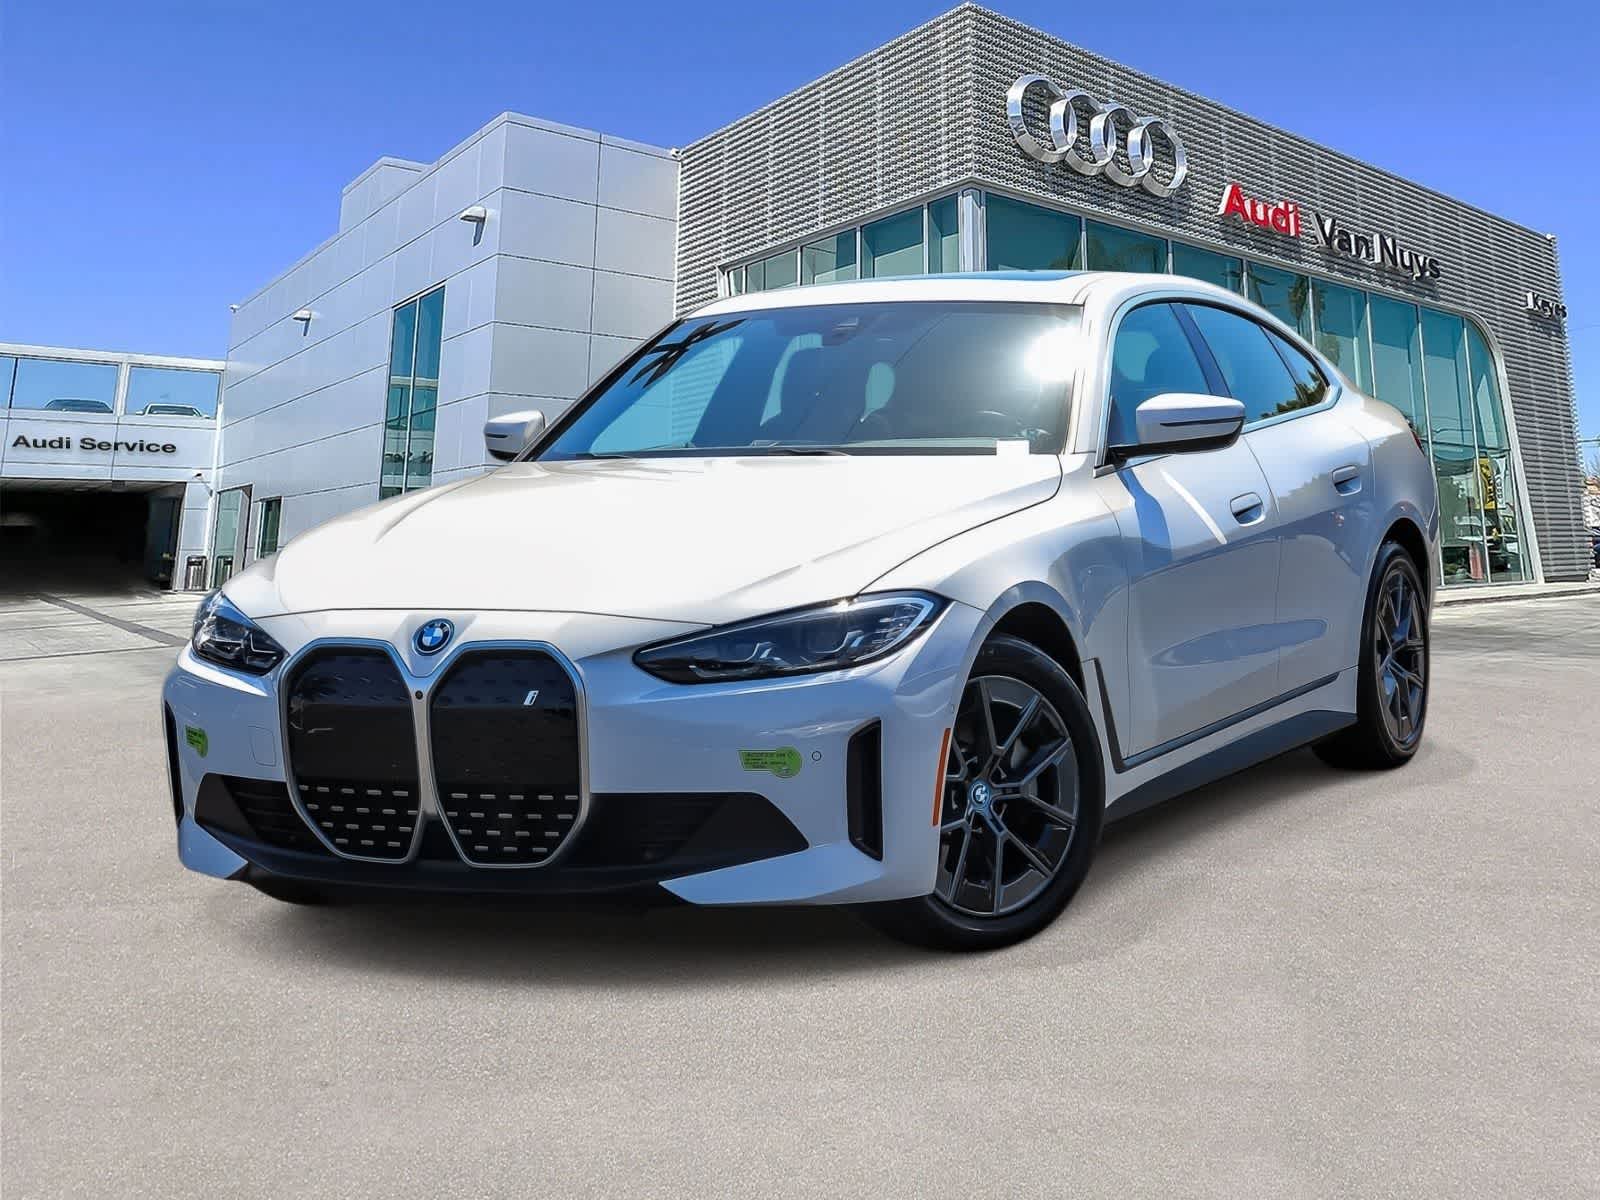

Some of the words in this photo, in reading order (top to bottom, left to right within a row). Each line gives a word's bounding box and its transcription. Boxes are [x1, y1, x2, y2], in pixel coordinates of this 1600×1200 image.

[1219, 183, 1301, 237] Audi
[1312, 212, 1370, 260] Van
[1374, 233, 1441, 280] Nuys
[1528, 292, 1567, 318] Keyes
[12, 435, 71, 449] Audi
[79, 437, 177, 453] Service
